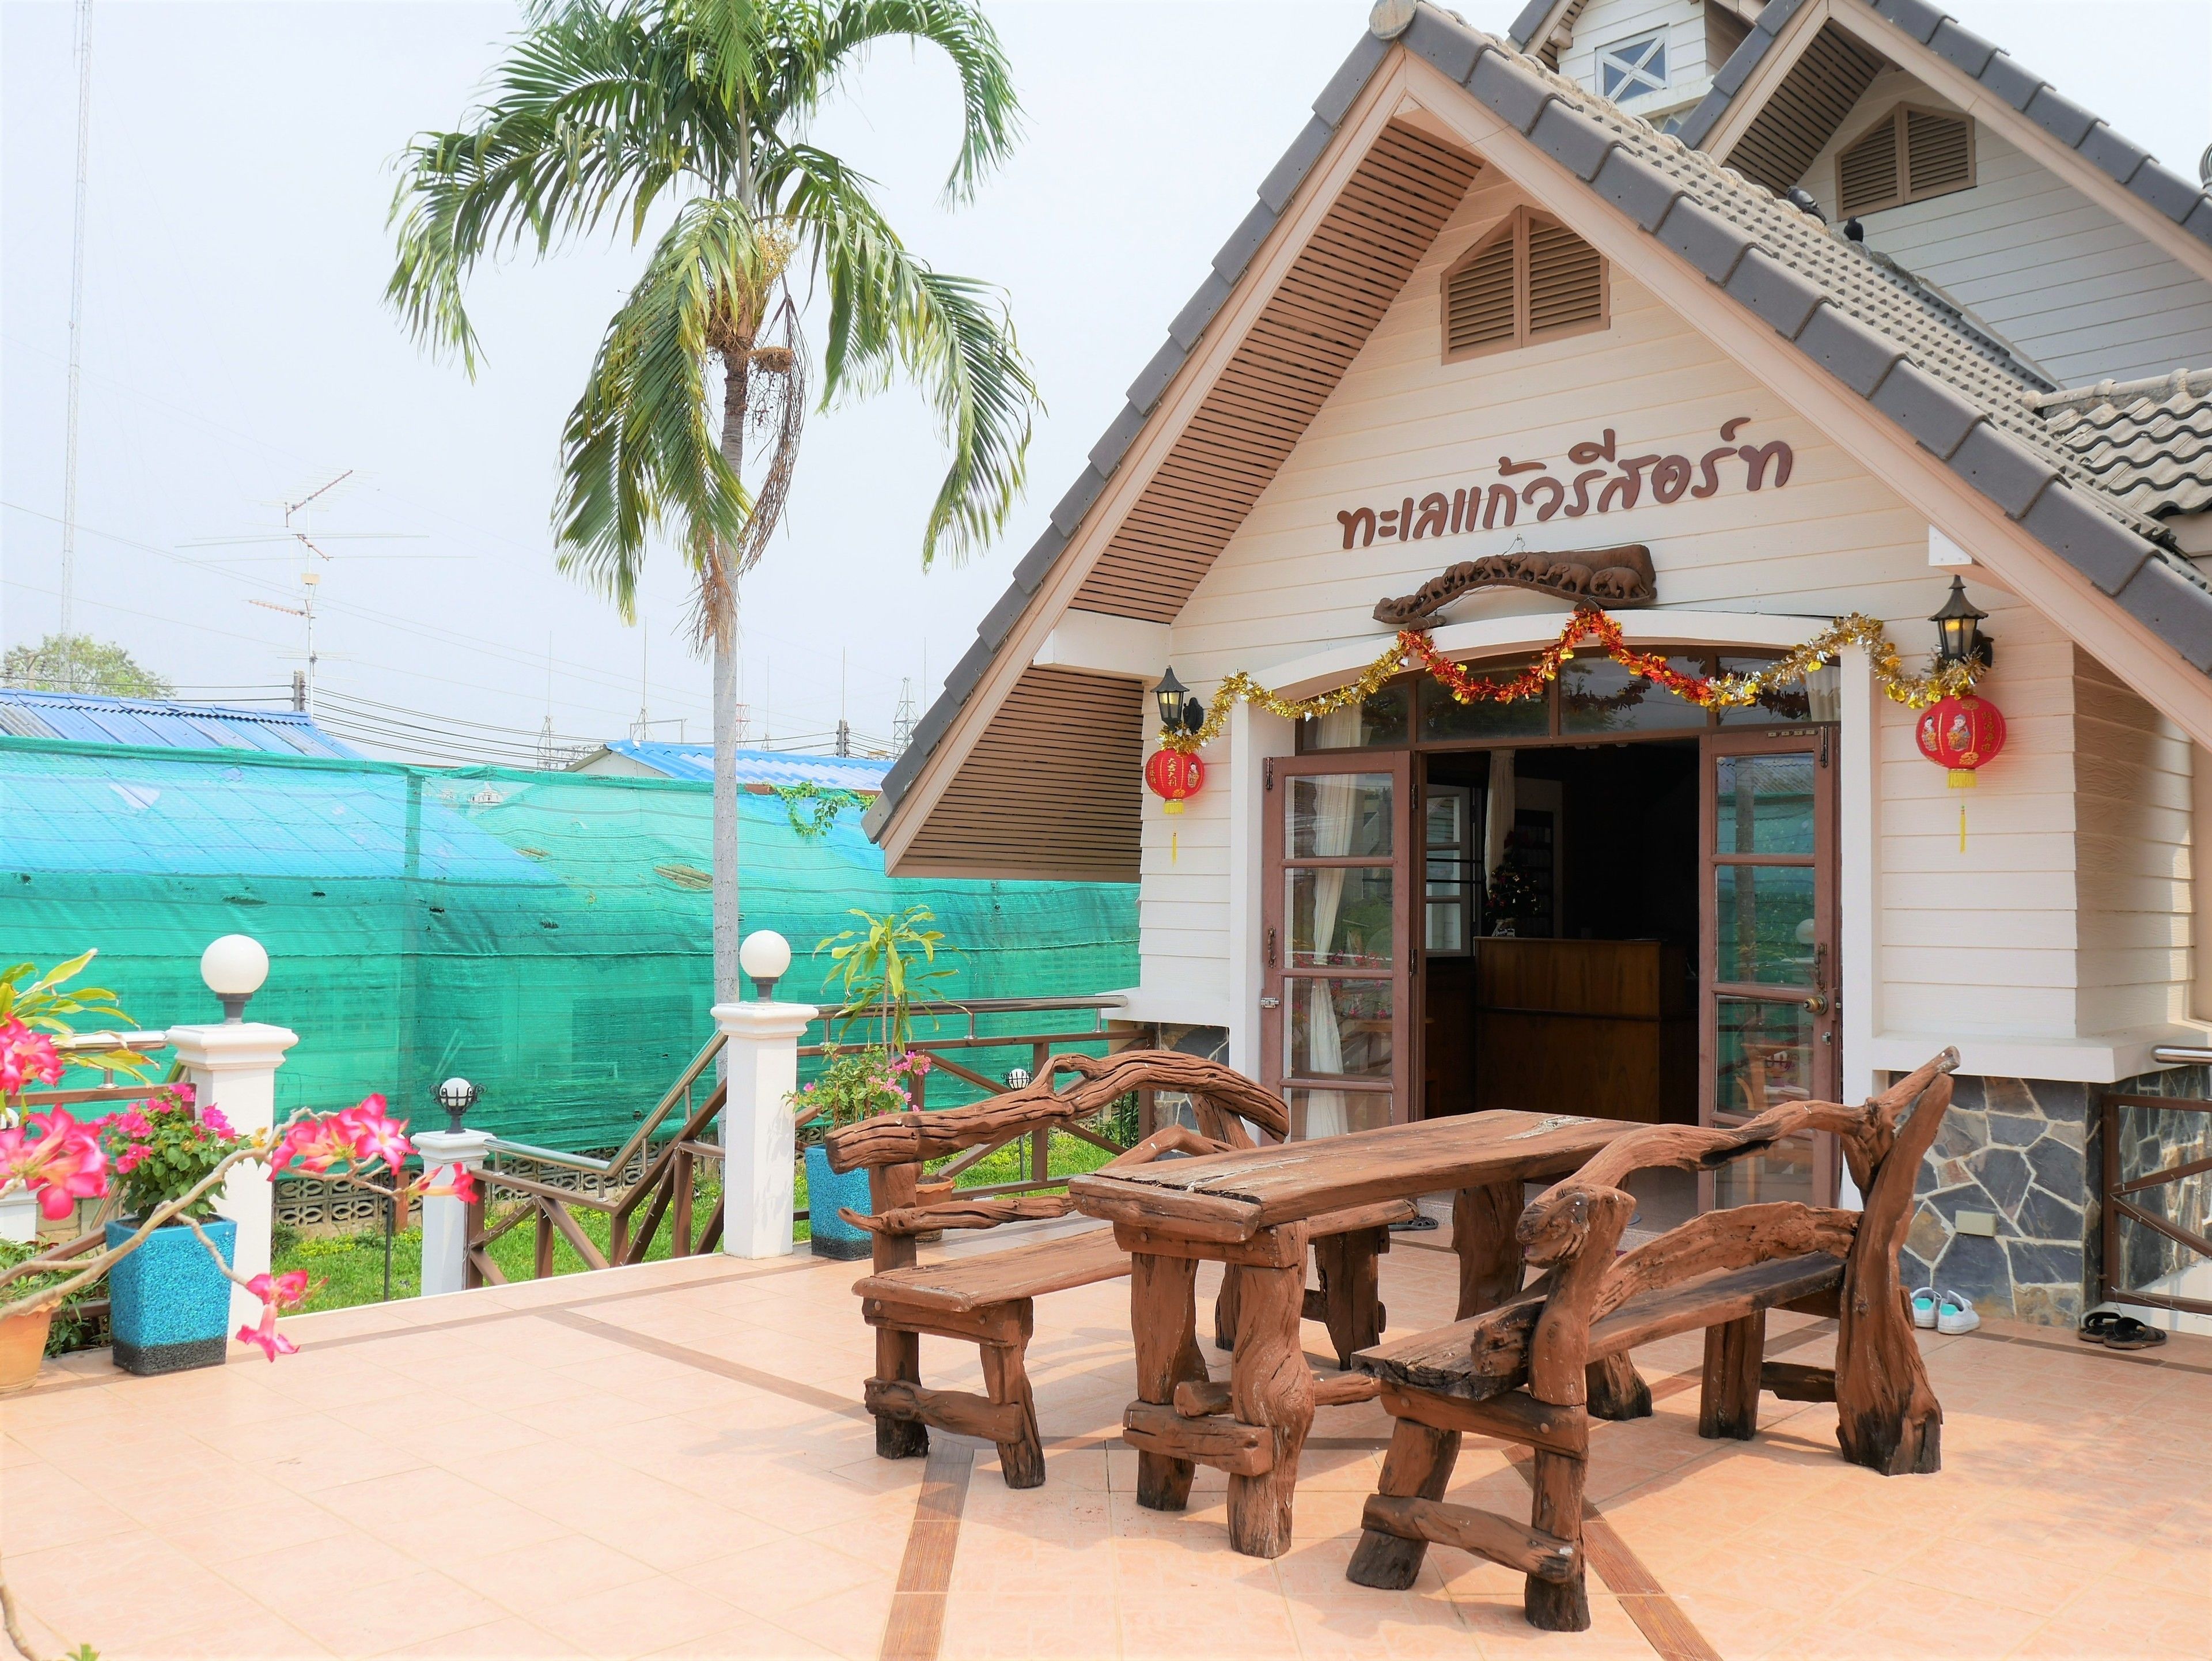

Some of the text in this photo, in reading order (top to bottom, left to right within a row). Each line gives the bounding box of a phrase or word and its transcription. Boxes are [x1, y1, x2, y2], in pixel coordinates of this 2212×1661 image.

[1336, 417, 1793, 550] ทะเลแก้วรีสอร์ท
[1167, 757, 1177, 786] 大吉大利
